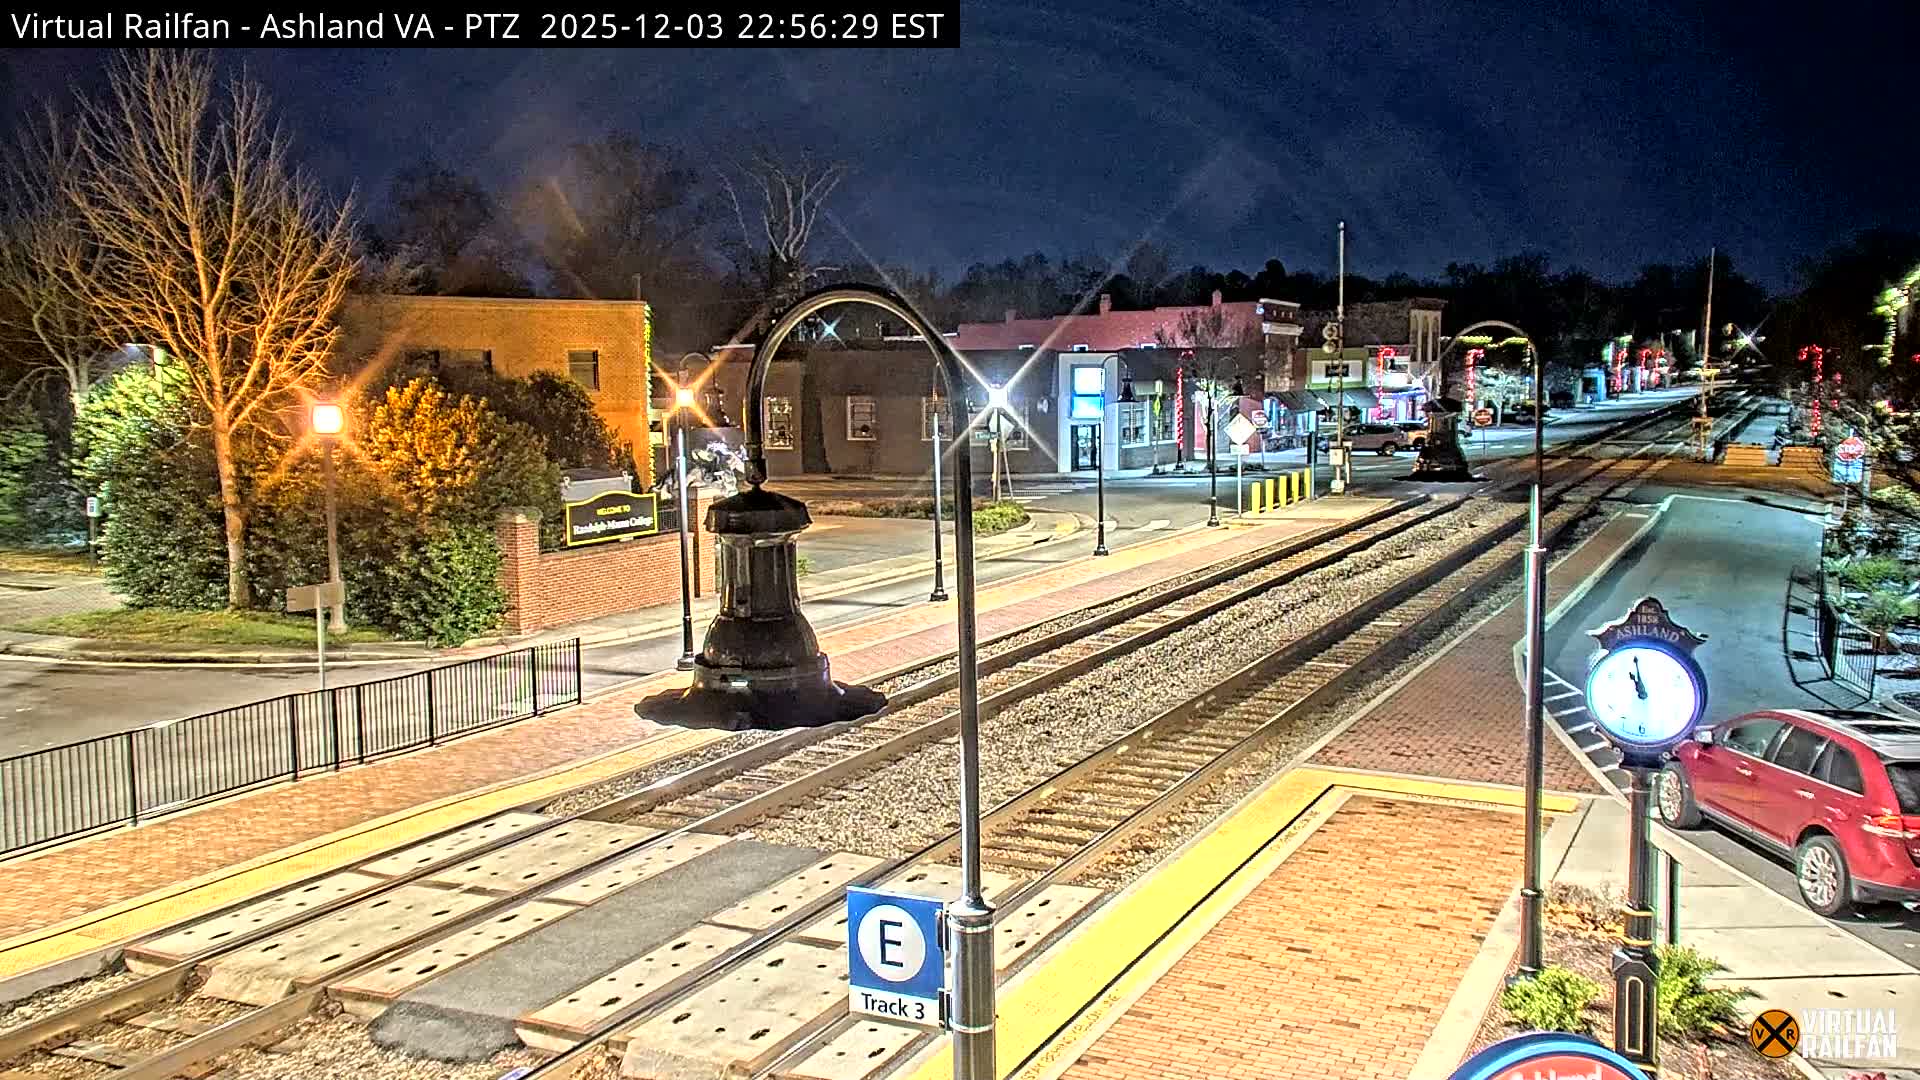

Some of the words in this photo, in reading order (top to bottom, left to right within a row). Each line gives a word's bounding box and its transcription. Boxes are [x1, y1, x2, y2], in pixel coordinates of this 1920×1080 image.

[1616, 625, 1680, 643] ASHLAND
[880, 919, 904, 968] E
[861, 993, 908, 1017] Track
[915, 1002, 925, 1020] 3
